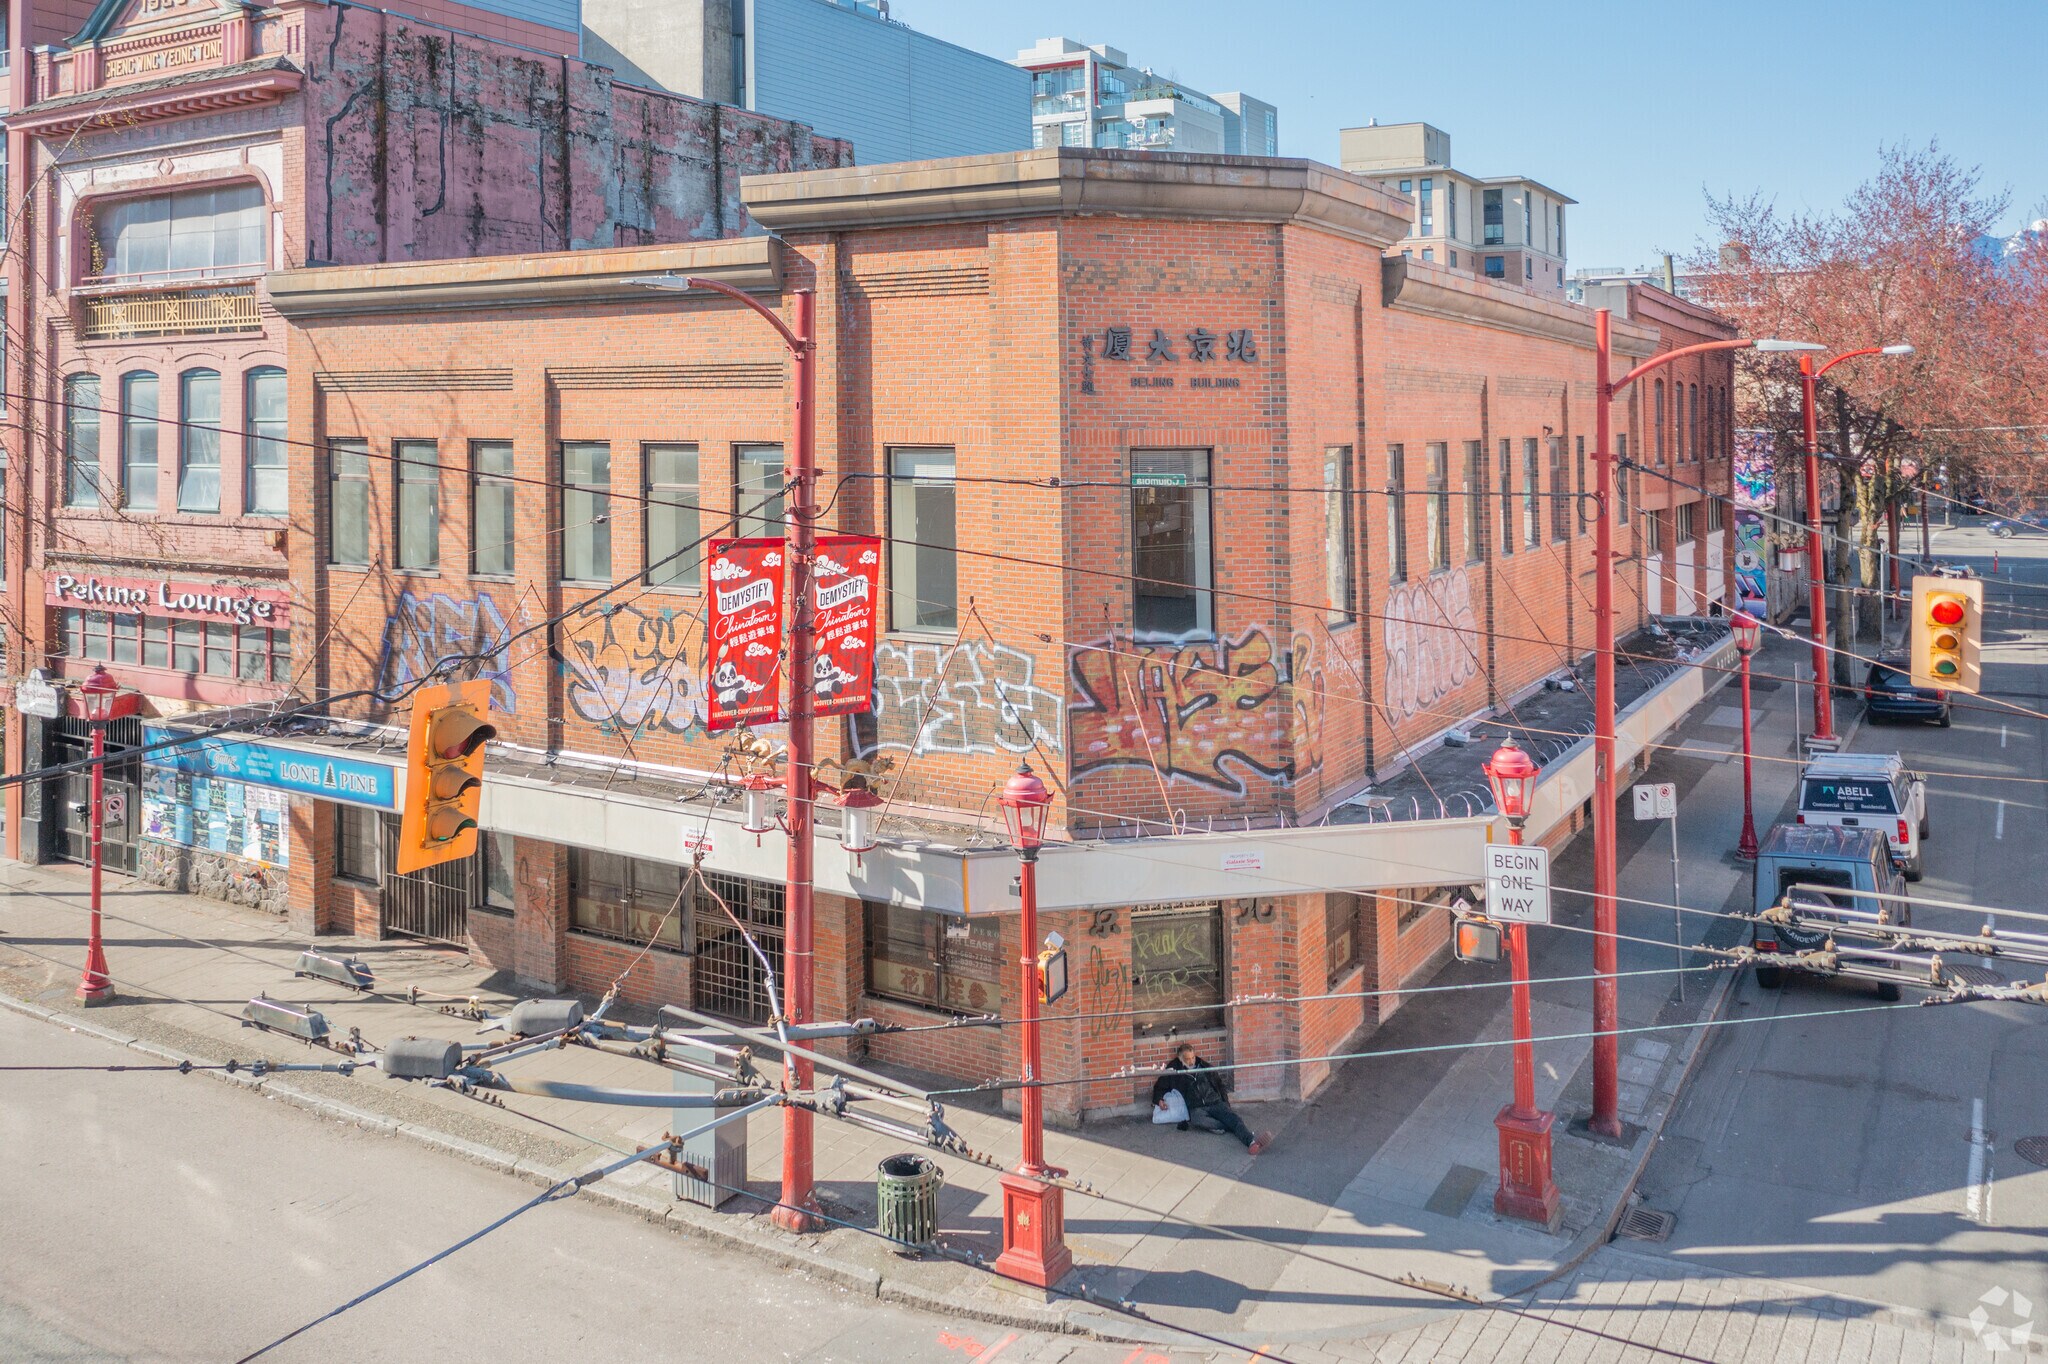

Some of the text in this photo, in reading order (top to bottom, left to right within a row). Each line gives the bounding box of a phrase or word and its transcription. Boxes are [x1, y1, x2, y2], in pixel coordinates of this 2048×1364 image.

[1131, 377, 1241, 389] BEIJING BUILDING
[55, 574, 275, 625] Peking Lounge
[721, 582, 770, 613] DEMYSTIFY
[819, 578, 865, 608] DEMYSTIFY
[714, 608, 777, 640] Chinatown
[814, 603, 871, 634] Chinatown
[814, 695, 866, 707] NCOUVER-CHINATOWN.COM
[281, 762, 320, 784] LONE
[340, 772, 377, 794] PINE
[1837, 786, 1874, 797] ABELL
[1494, 854, 1539, 871] BEGIN
[1500, 875, 1534, 891] ONE
[1501, 897, 1534, 914] WAY
[964, 938, 995, 952] LEASE
